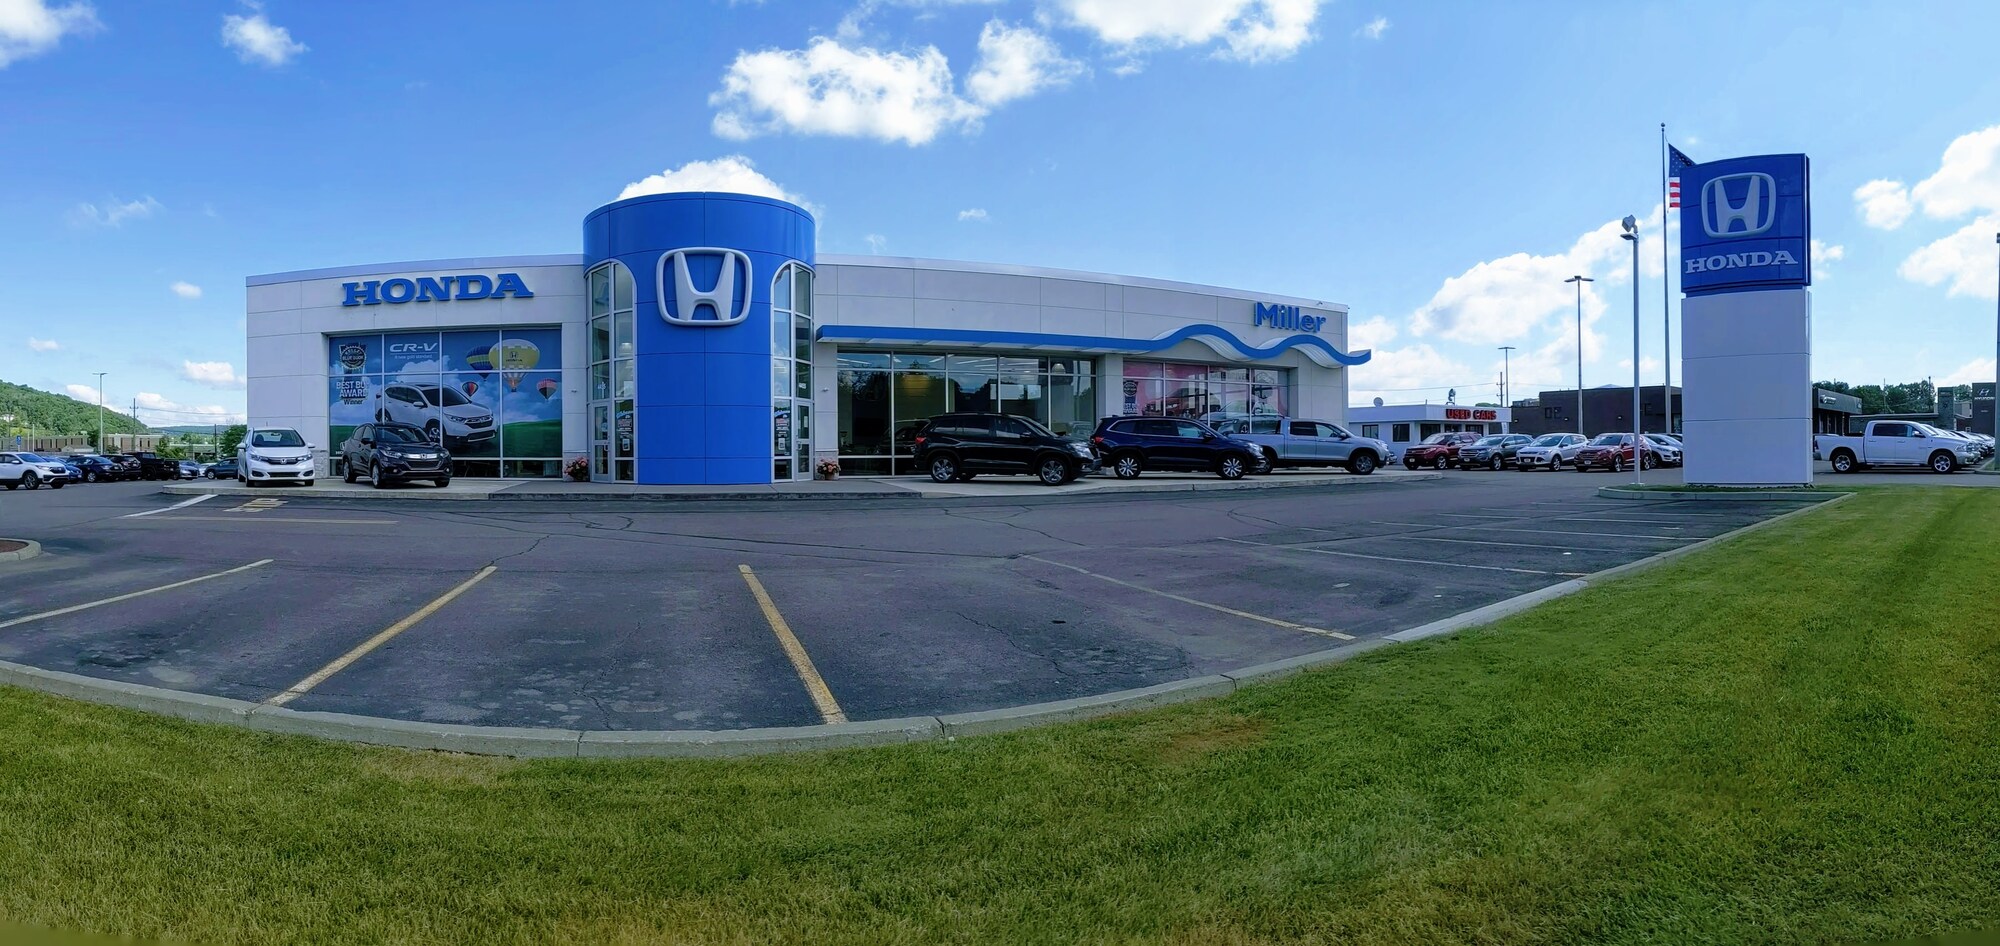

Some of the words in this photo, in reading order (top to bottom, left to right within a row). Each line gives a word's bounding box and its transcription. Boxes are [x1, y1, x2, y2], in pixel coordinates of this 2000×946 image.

[1685, 250, 1798, 274] HONDA
[342, 273, 534, 306] HONDA
[1254, 302, 1327, 333] Miller
[390, 342, 438, 352] CR-V
[336, 381, 354, 389] BEST
[339, 388, 368, 397] AWARD
[1446, 409, 1471, 419] USED
[1473, 410, 1497, 420] CARS
